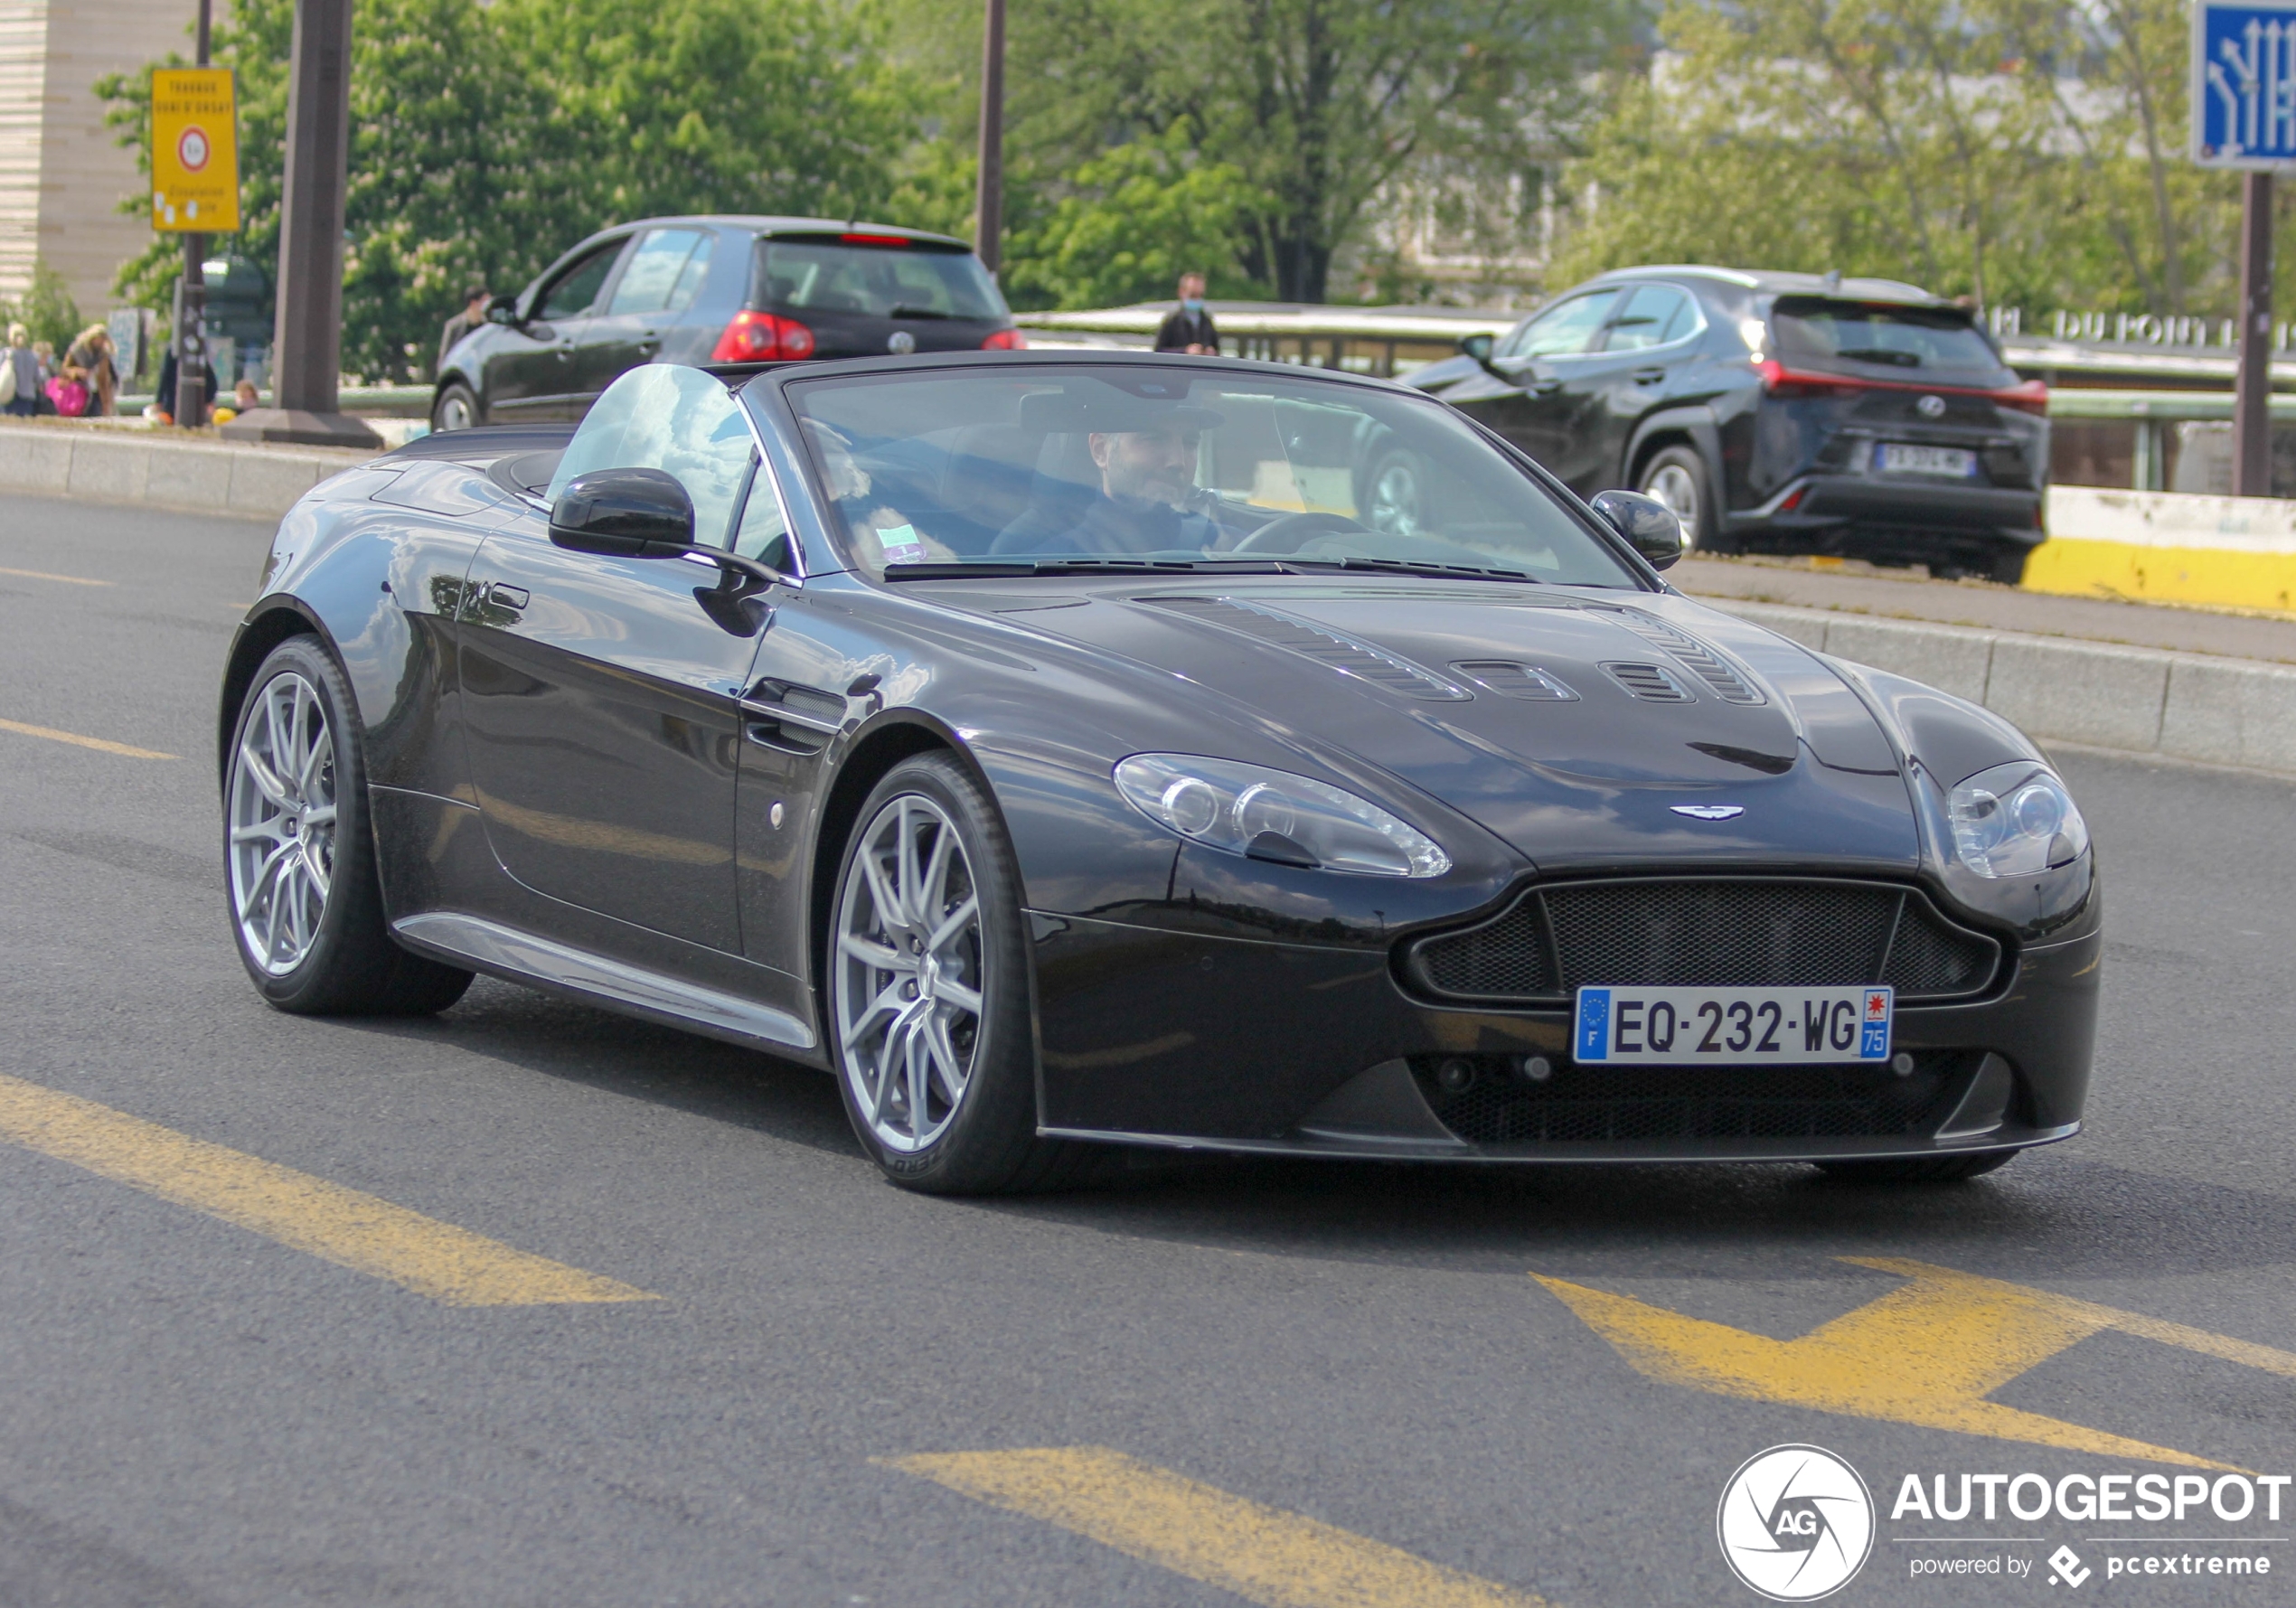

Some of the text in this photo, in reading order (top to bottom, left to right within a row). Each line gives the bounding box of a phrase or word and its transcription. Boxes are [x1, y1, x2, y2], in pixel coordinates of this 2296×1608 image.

[1614, 1000, 1857, 1054] EQ-232-WG
[1587, 1030, 1598, 1047] F
[1864, 1030, 1885, 1052] 75
